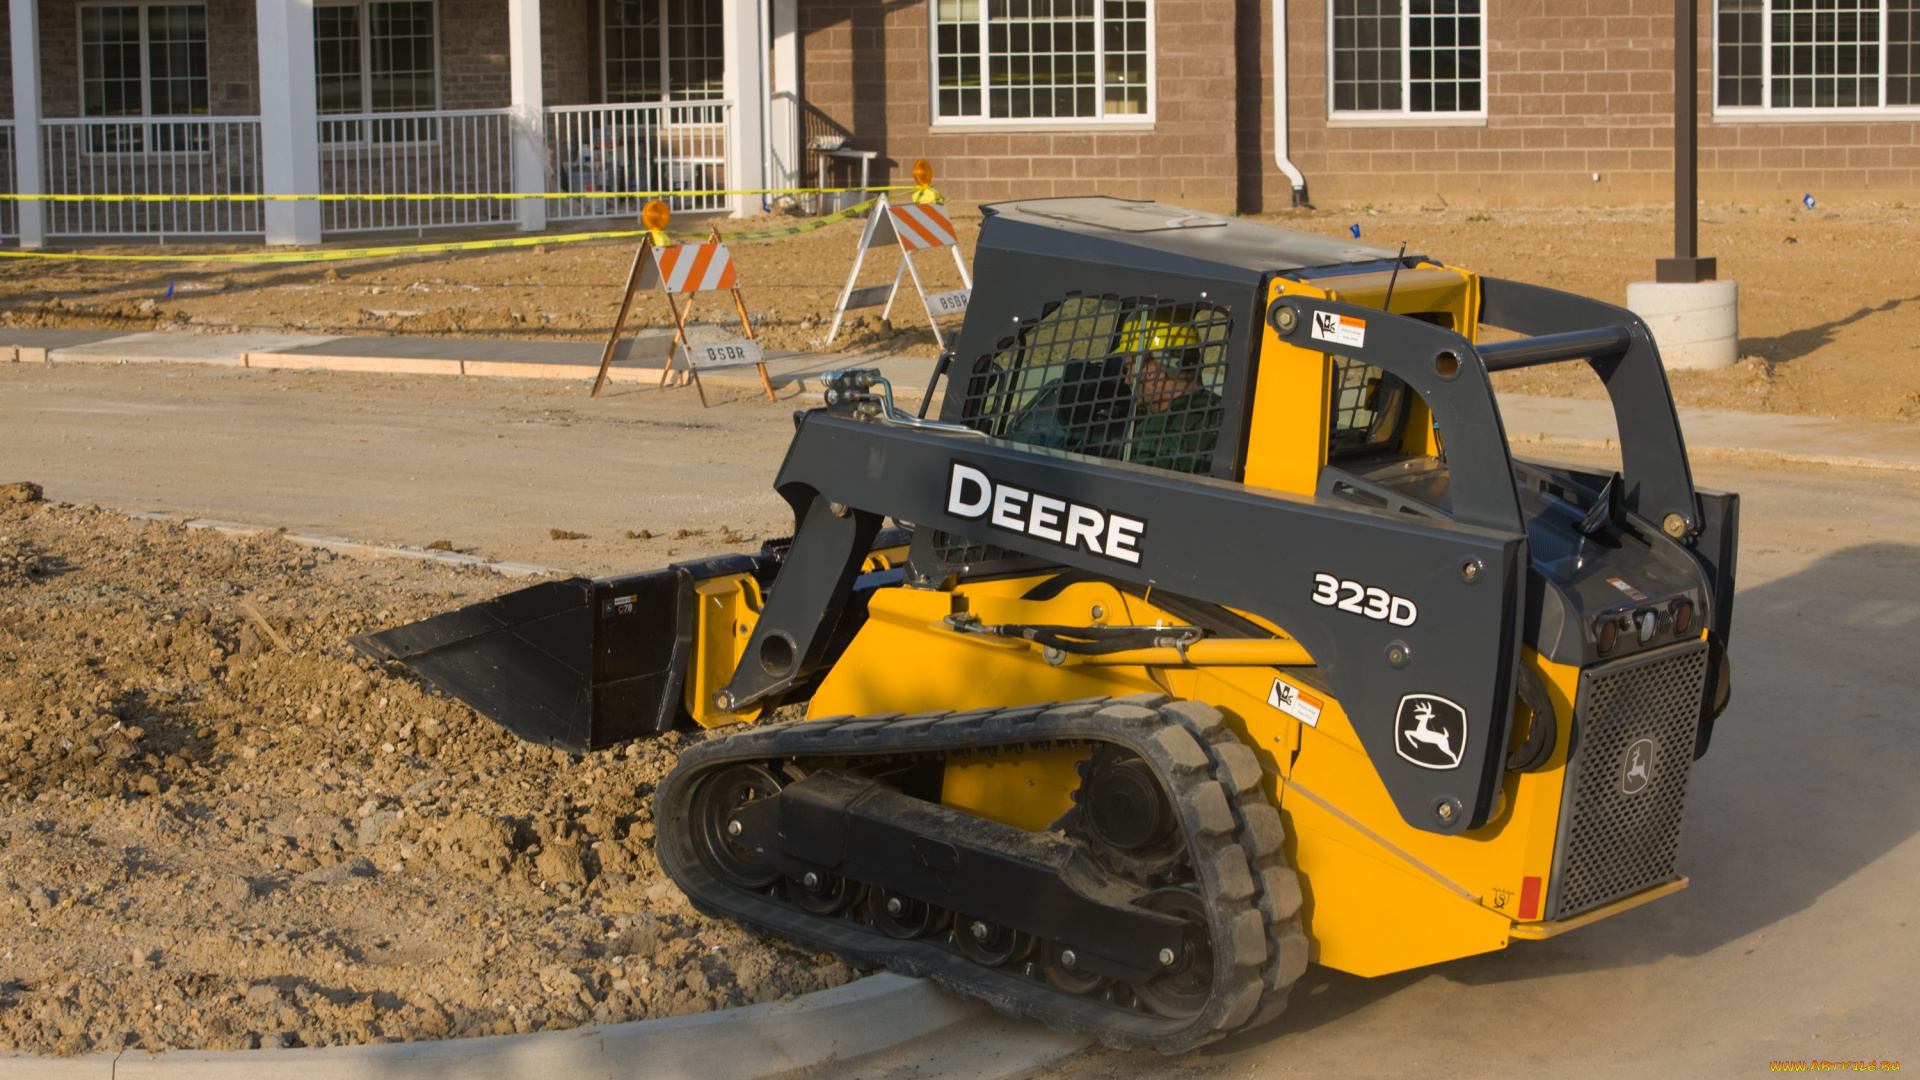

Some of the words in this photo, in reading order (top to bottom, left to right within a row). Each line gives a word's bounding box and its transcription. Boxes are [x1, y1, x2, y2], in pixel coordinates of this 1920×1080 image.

[706, 346, 745, 361] BSBR
[947, 462, 1145, 565] DEERE
[1311, 572, 1418, 628] 323D
